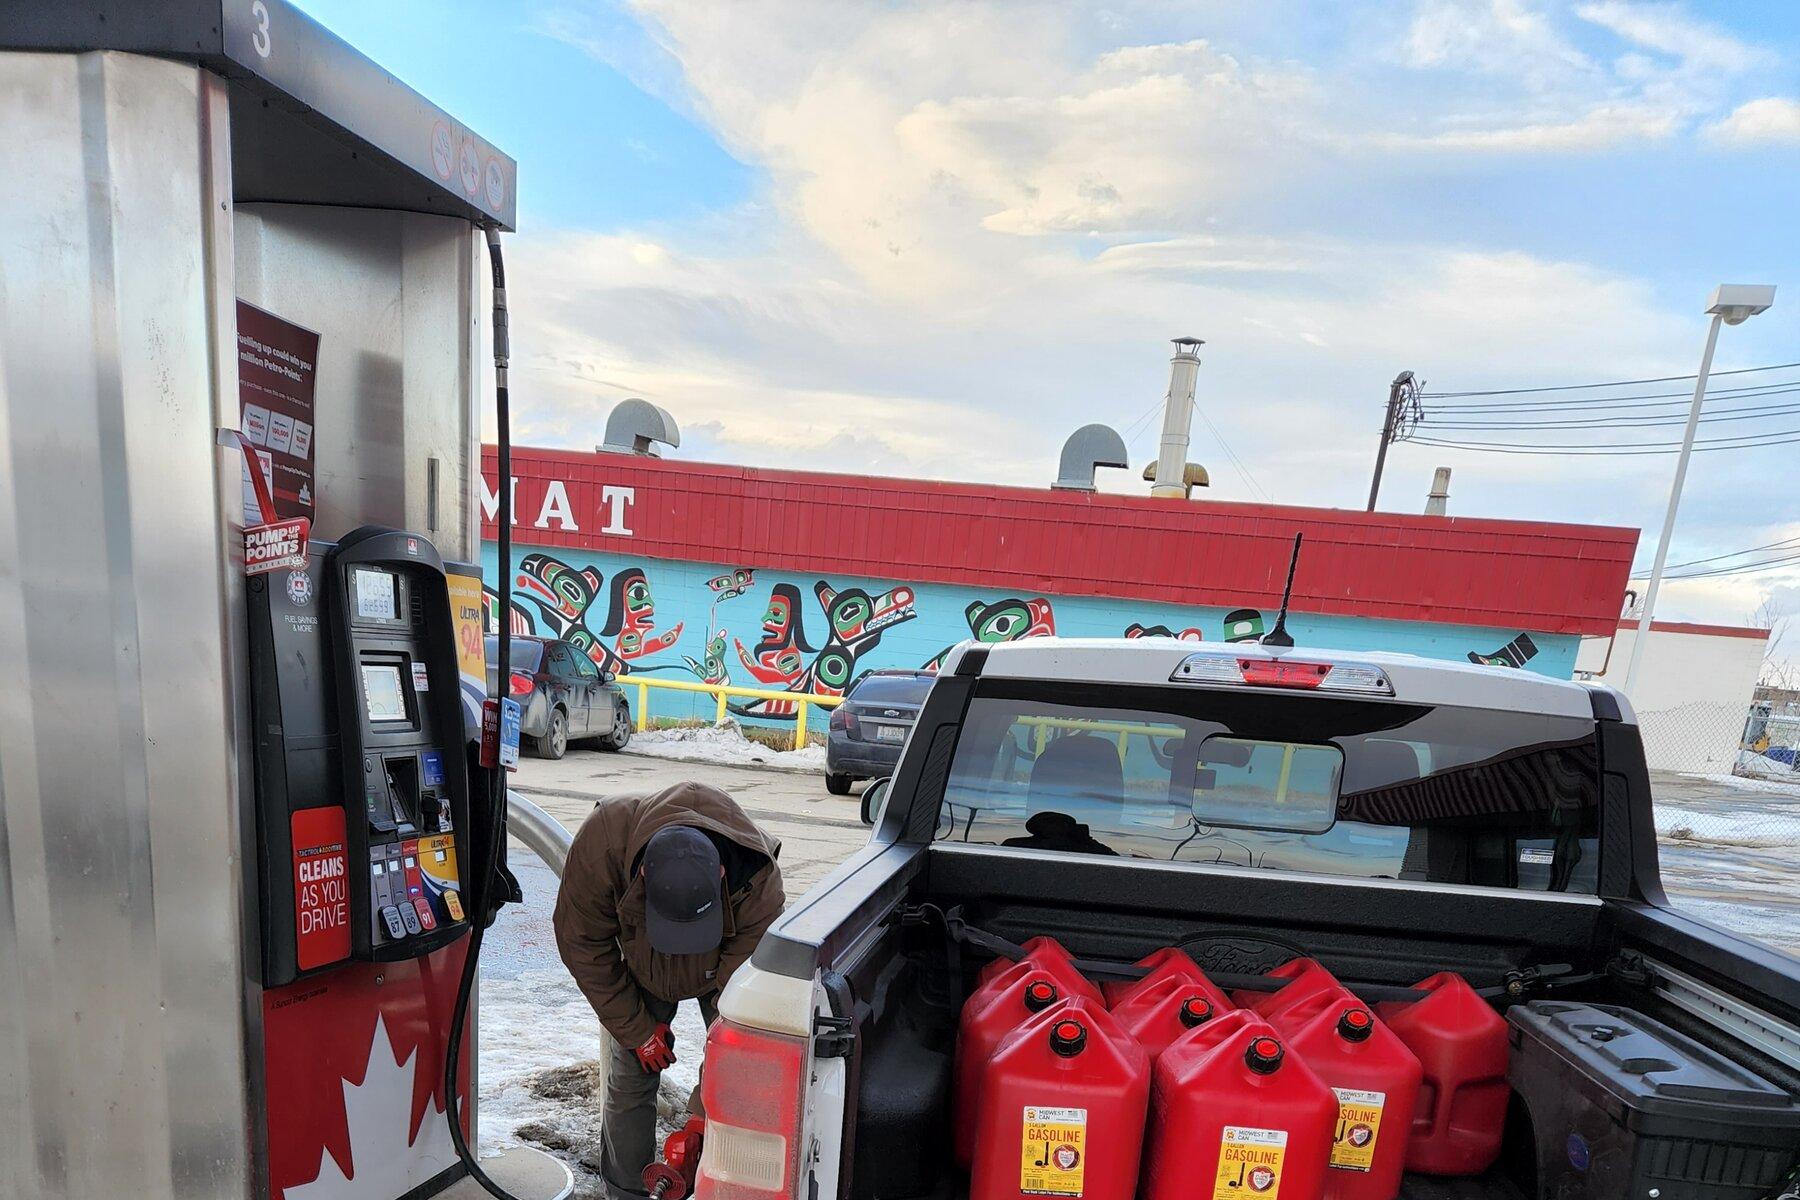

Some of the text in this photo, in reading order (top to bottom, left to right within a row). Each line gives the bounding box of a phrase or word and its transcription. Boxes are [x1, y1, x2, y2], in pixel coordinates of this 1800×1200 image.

[251, 1, 271, 58] 3
[241, 352, 263, 367] million
[262, 344, 272, 355] up
[272, 348, 290, 362] could
[300, 360, 312, 371] you
[246, 525, 300, 547] PUMP UP
[246, 540, 299, 562] POINTS
[284, 614, 318, 625] FUEL SAVINGS
[461, 606, 480, 623] ULTRA
[297, 624, 312, 633] MORE
[461, 624, 482, 660] 94
[299, 856, 345, 883] CLEANS
[301, 879, 345, 909] AS YOU
[422, 912, 432, 924] 91
[449, 905, 460, 916] 94
[301, 903, 346, 935] DRIVE
[390, 921, 400, 933] 87
[406, 916, 416, 928] 89
[1341, 1108, 1377, 1122] SOLINE
[1028, 1128, 1080, 1143] GASOLINE
[1238, 1130, 1265, 1138] MIDWEST
[1225, 1148, 1279, 1165] GASOLINE
